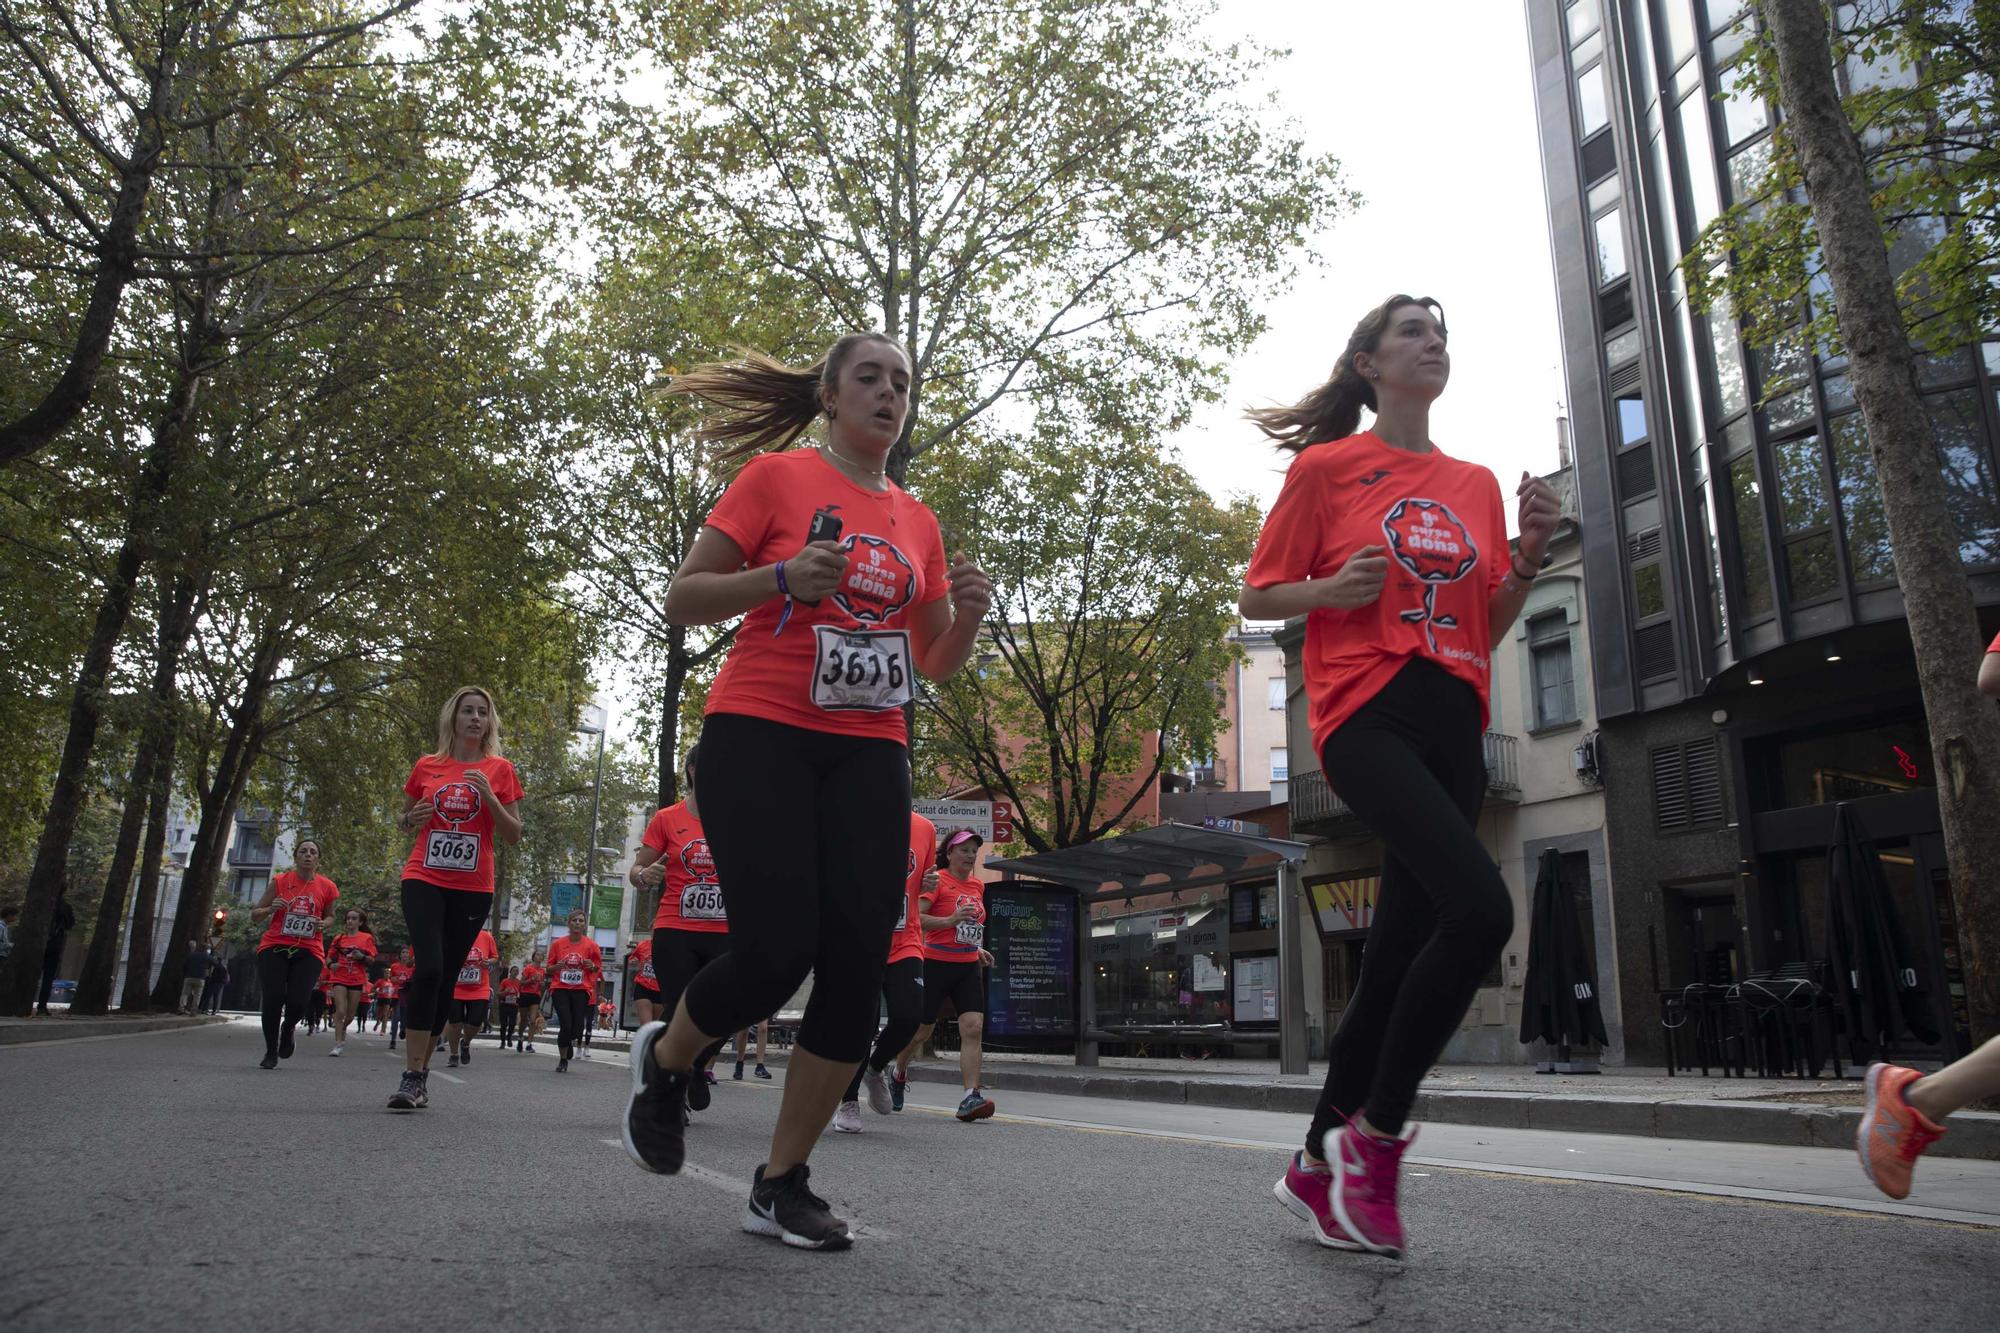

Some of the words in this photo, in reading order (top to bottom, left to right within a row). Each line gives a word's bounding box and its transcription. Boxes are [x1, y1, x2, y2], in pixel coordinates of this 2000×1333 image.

[1408, 534, 1460, 554] dona
[857, 562, 896, 581] cursa
[848, 572, 896, 599] dona
[822, 649, 904, 689] 3616
[444, 801, 470, 810] dona
[912, 804, 937, 815] Ciutat
[938, 805, 948, 815] de
[949, 805, 976, 816] Girona
[431, 840, 475, 860] 5063
[685, 893, 724, 910] 3050
[991, 903, 1034, 917] Futur
[286, 918, 313, 931] 3615
[1010, 916, 1042, 930] Fest
[960, 925, 982, 940] 1176
